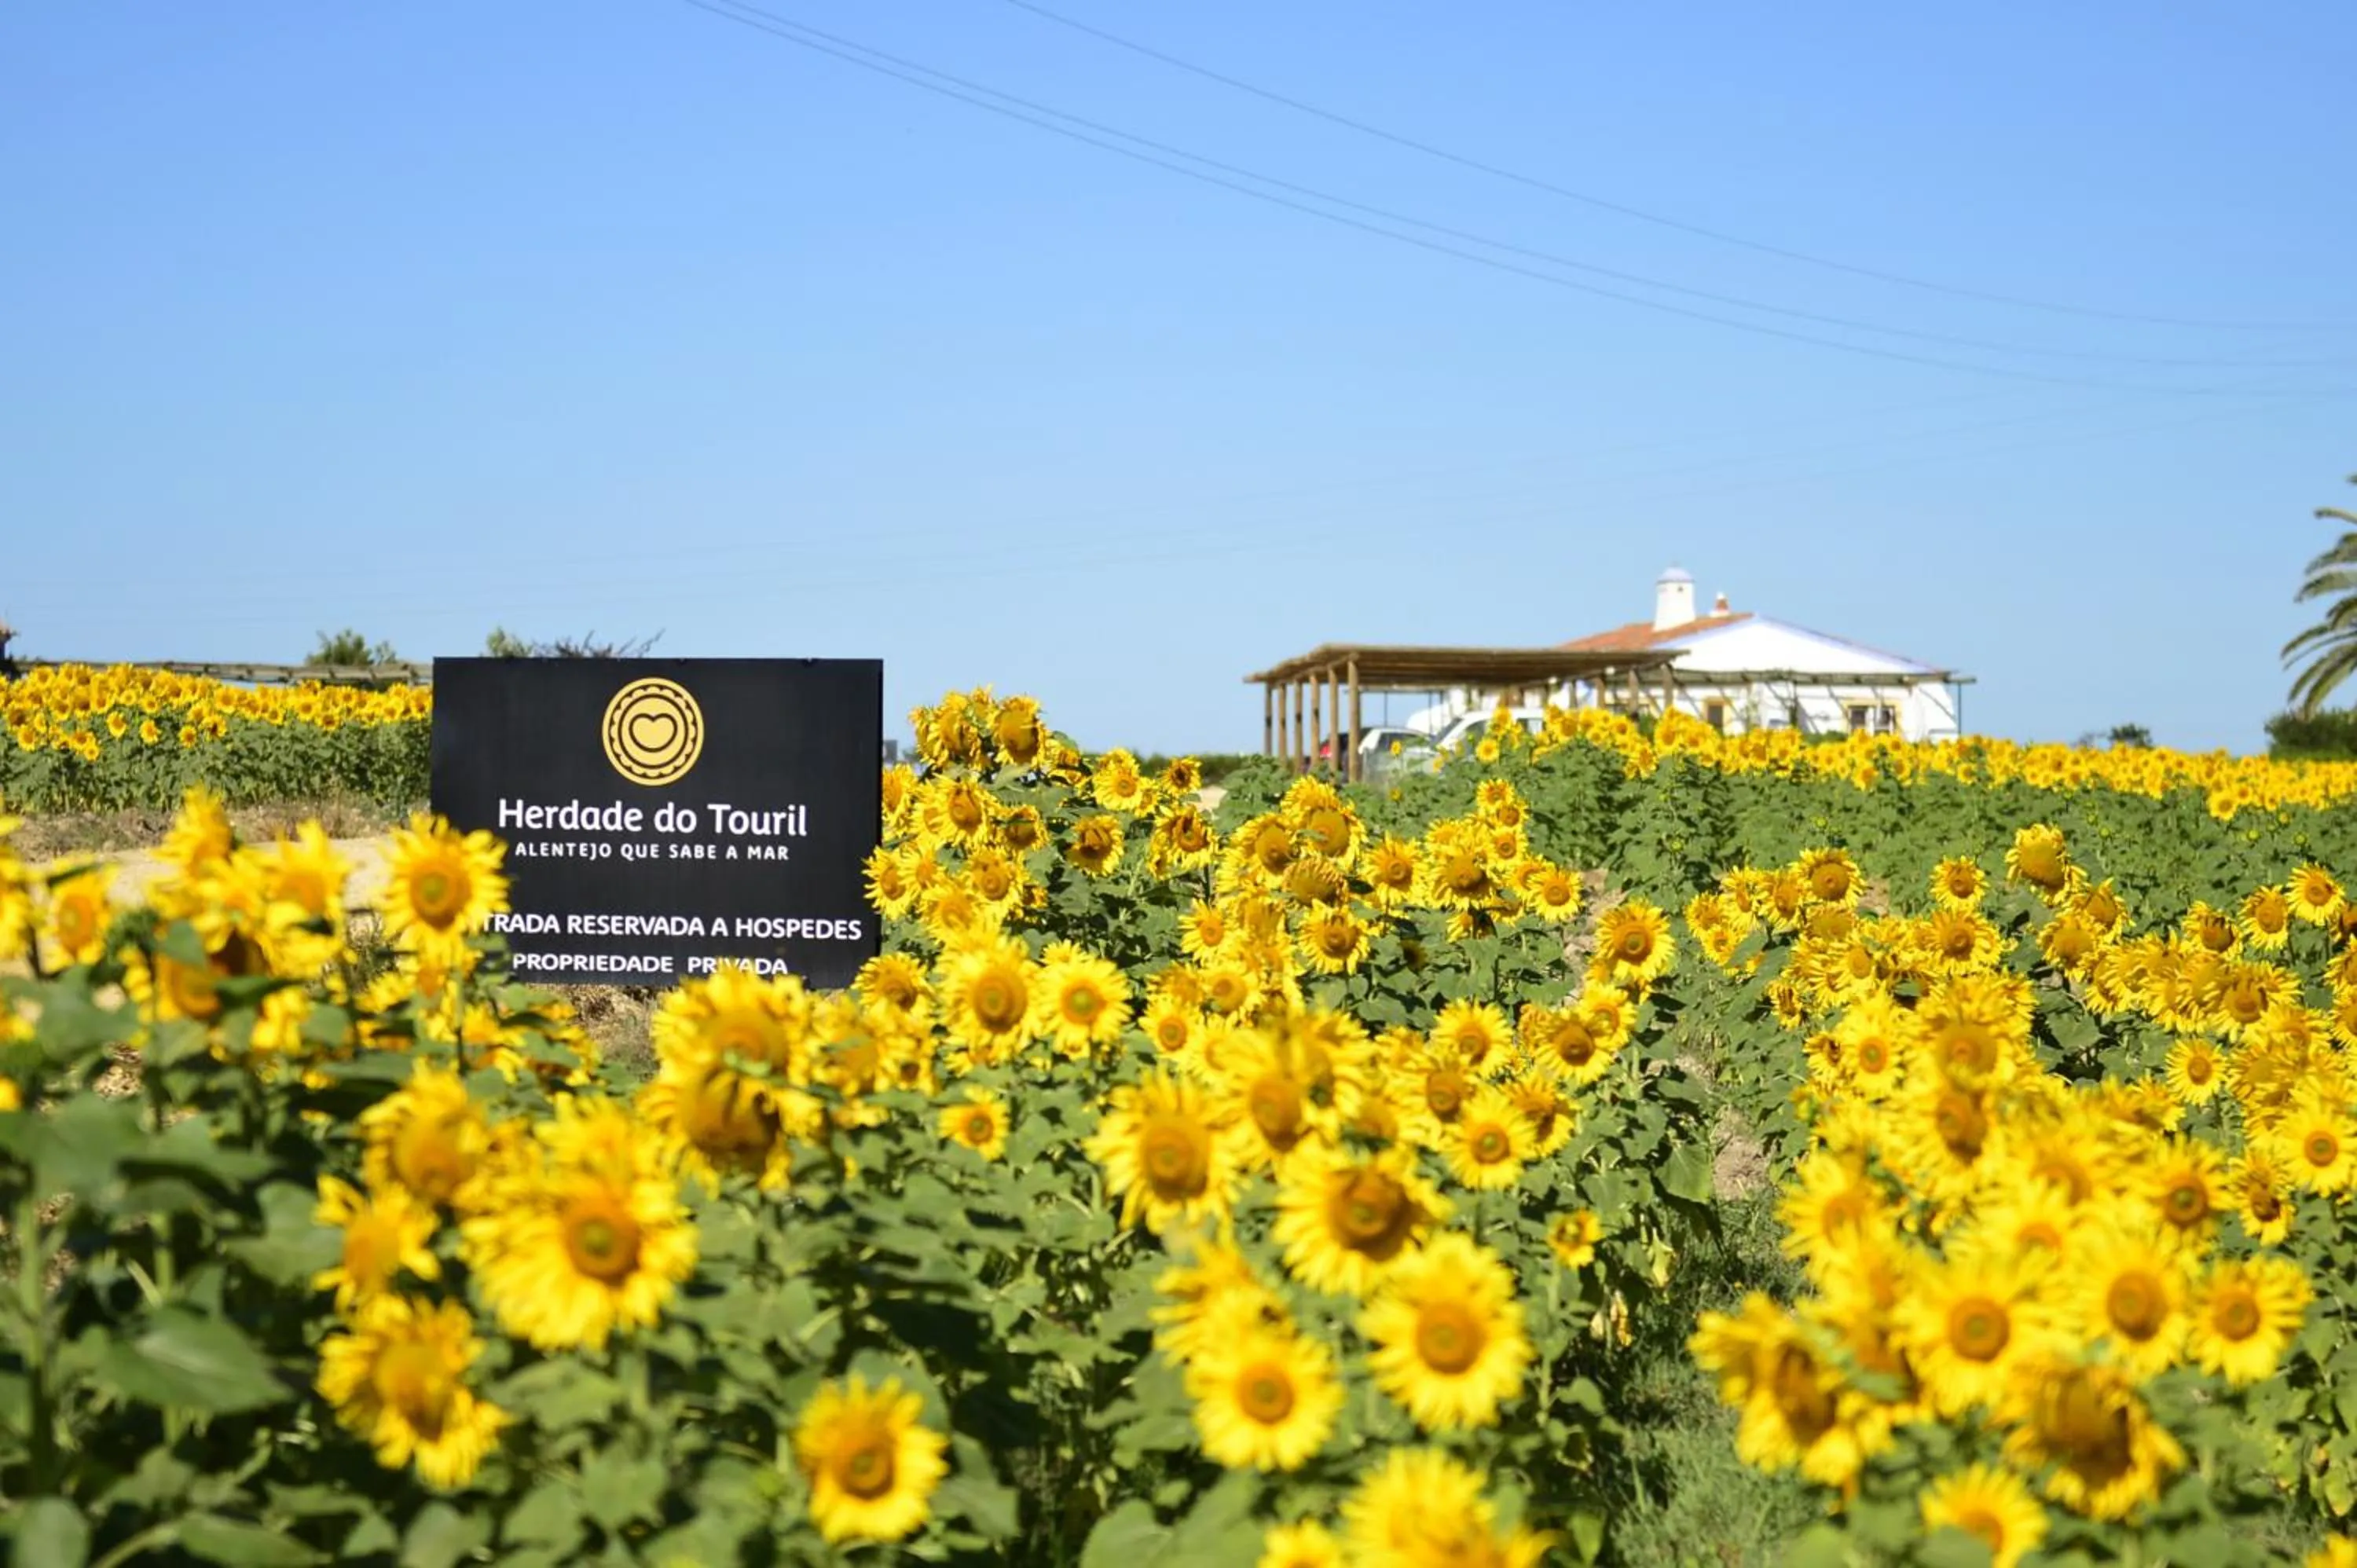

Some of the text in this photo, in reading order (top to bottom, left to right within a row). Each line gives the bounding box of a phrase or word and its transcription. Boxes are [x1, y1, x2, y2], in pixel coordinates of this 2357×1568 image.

[498, 798, 808, 837] Herdade do Touril
[515, 841, 790, 862] ALENTEJO QUE SABE A MAR
[482, 913, 862, 940] TRADA RESERVADA A HOSPEDES
[512, 952, 674, 973] PROPRIEDADE
